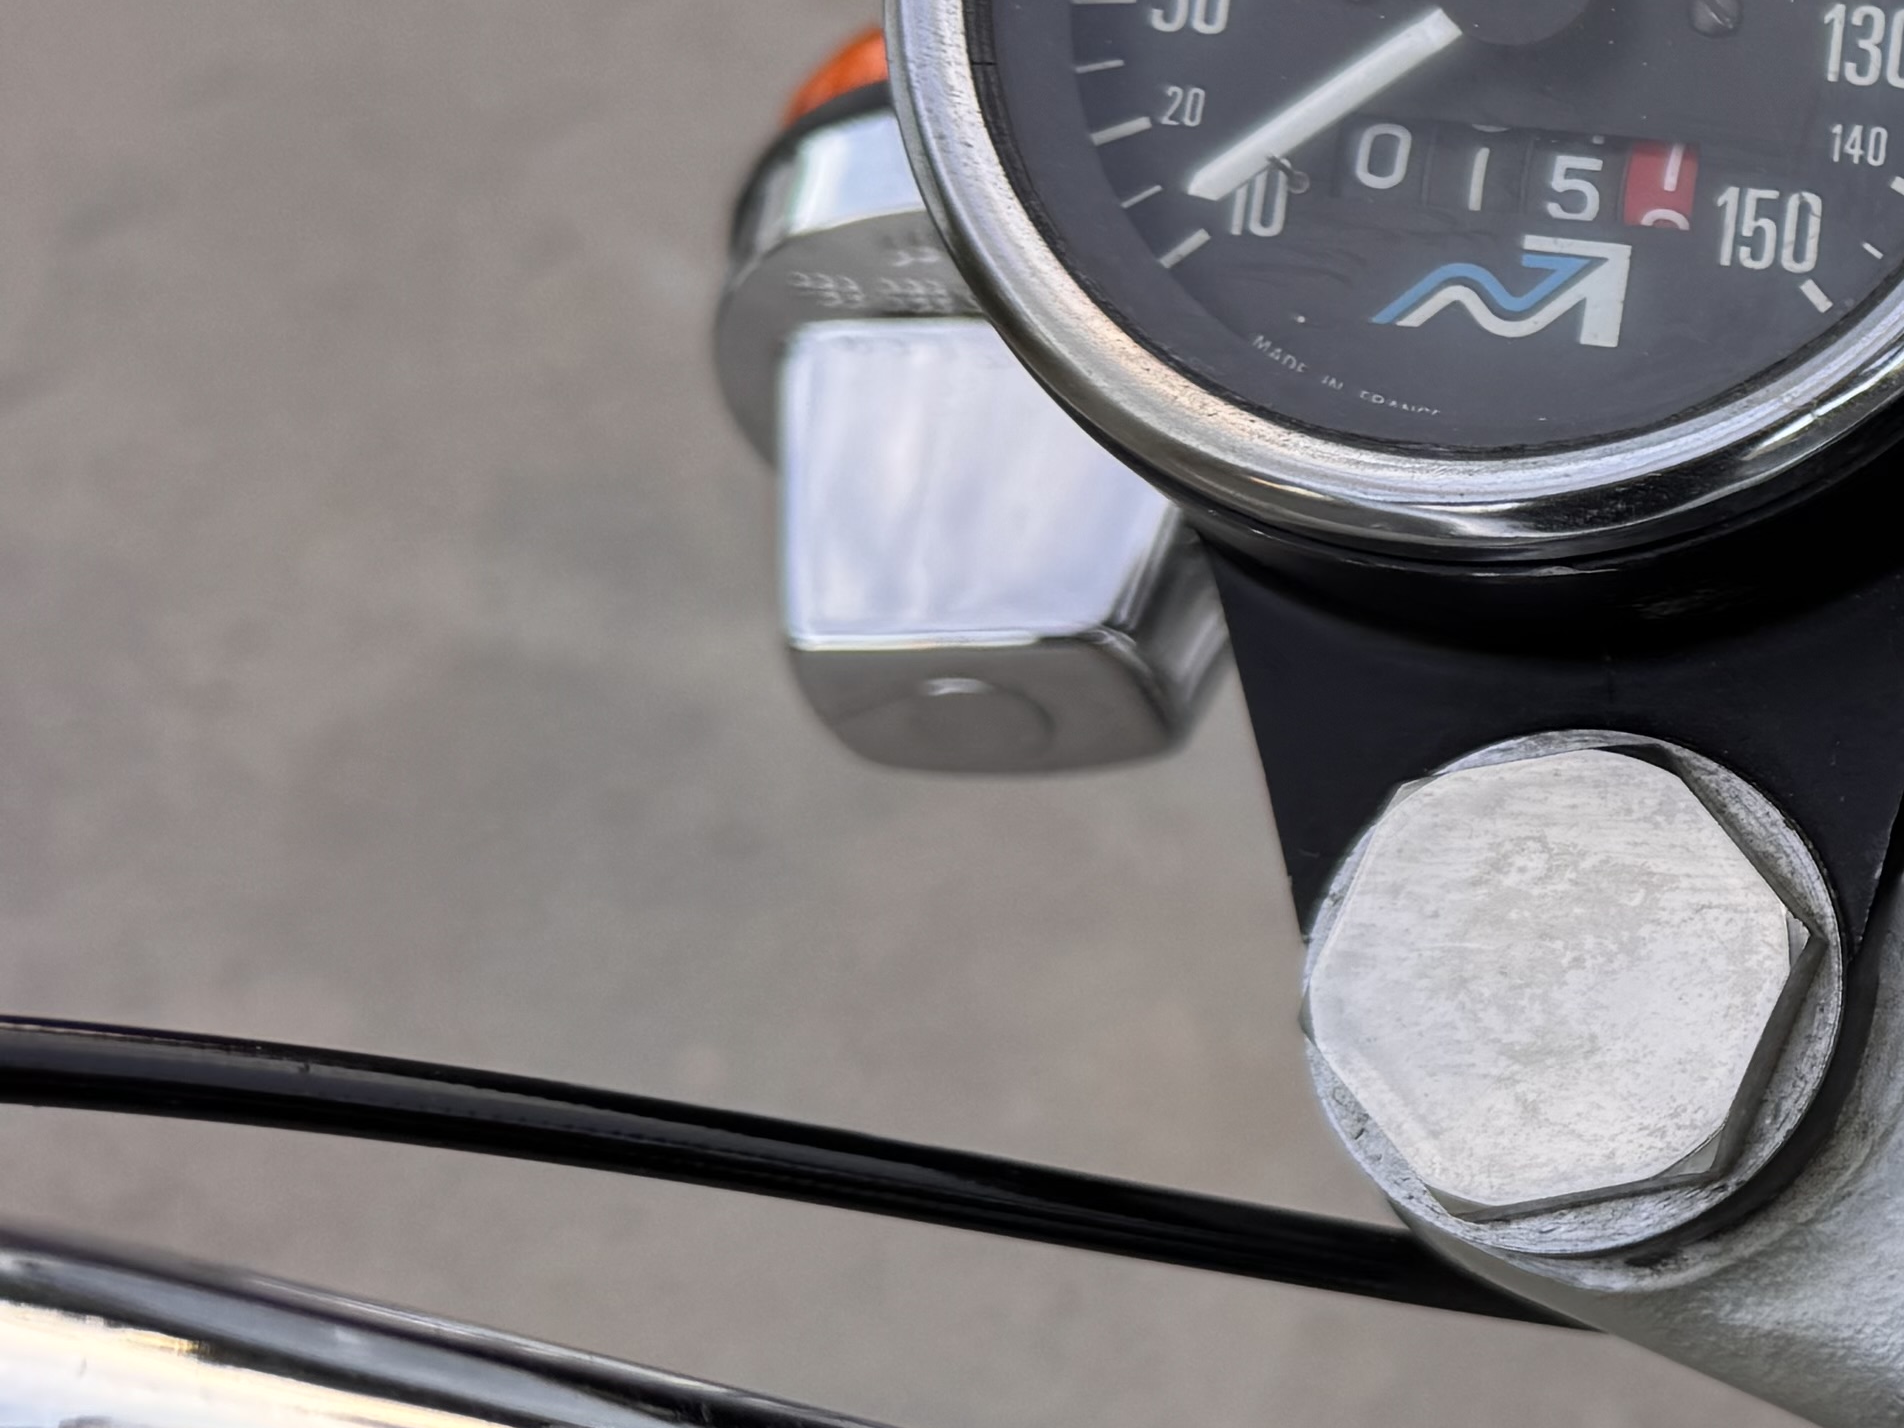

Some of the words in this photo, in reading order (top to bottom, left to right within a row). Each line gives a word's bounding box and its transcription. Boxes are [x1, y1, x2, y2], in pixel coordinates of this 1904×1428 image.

[1161, 86, 1205, 127] 20
[1832, 124, 1888, 166] 140
[1231, 158, 1291, 237] 10
[1717, 186, 1822, 273] 150
